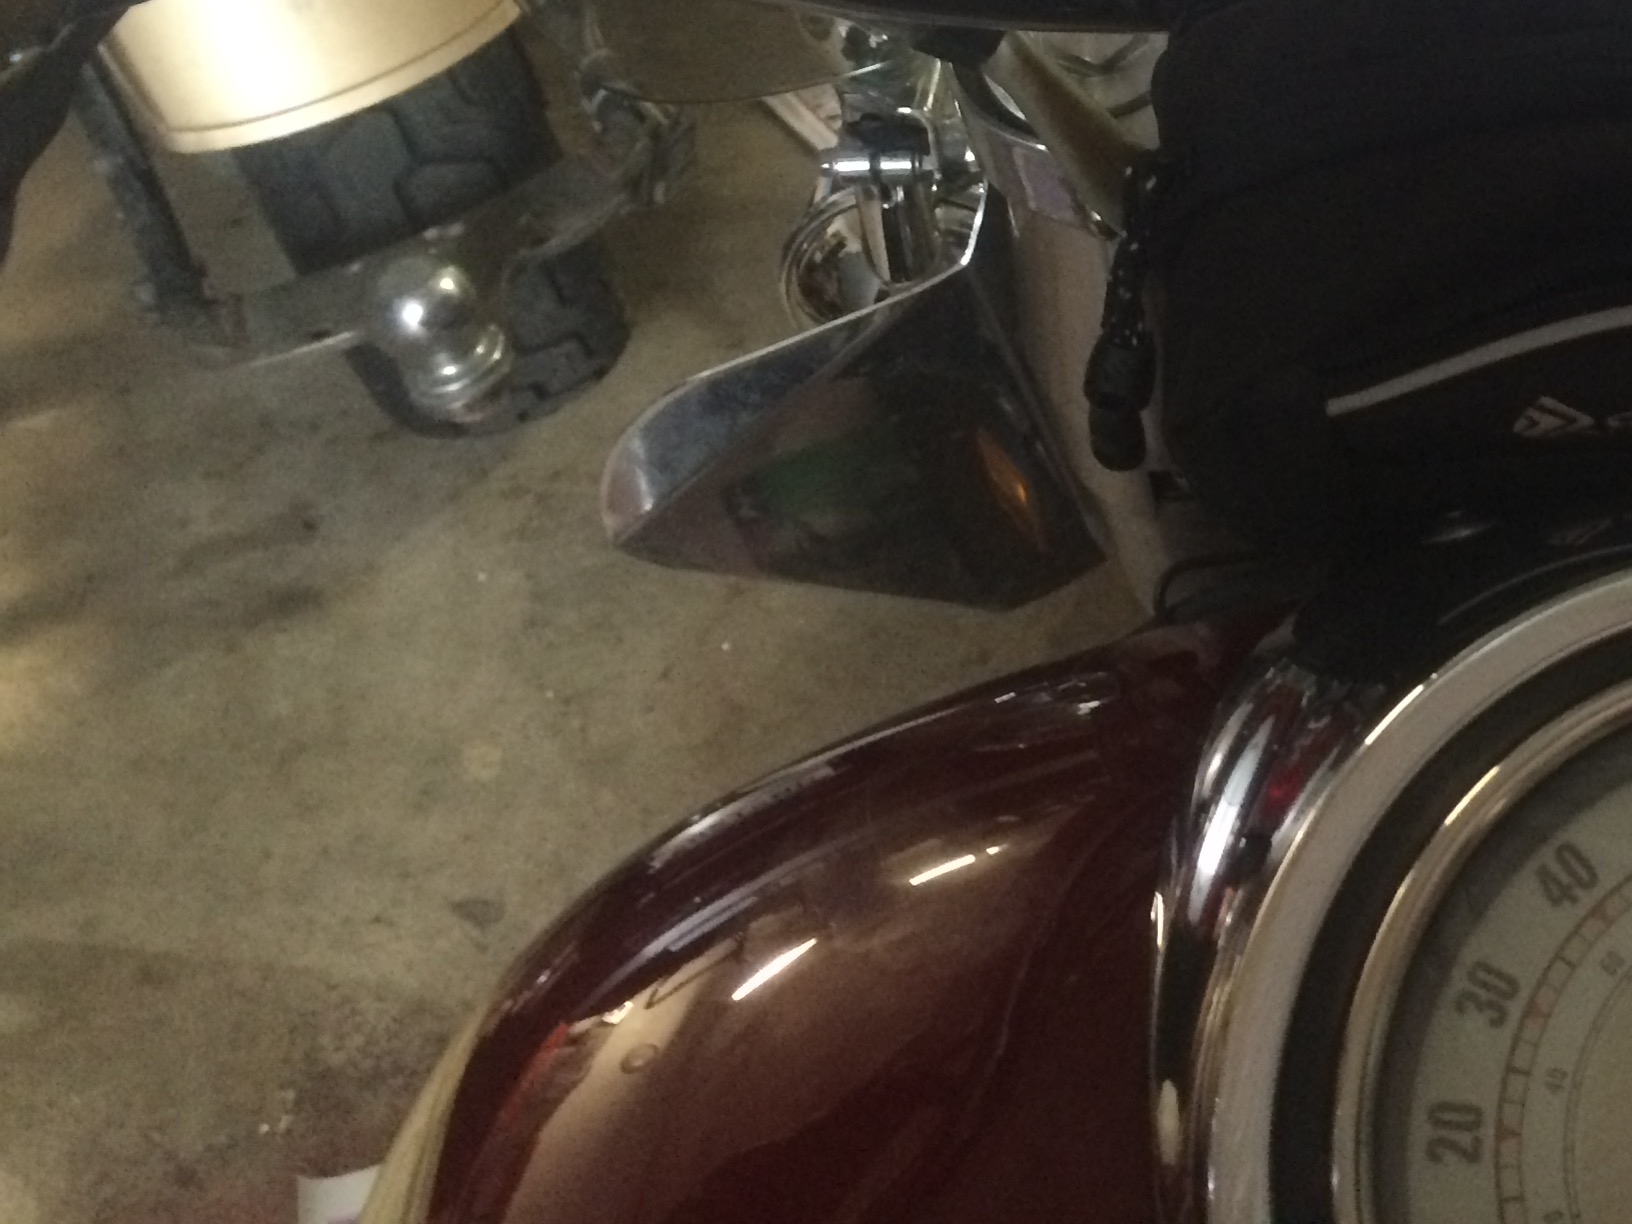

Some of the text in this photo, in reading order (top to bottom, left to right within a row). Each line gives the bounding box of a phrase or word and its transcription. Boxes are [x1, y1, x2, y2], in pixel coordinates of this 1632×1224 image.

[1537, 840, 1599, 910] 40
[1453, 960, 1521, 1030] 30
[1425, 1100, 1484, 1168] 20
